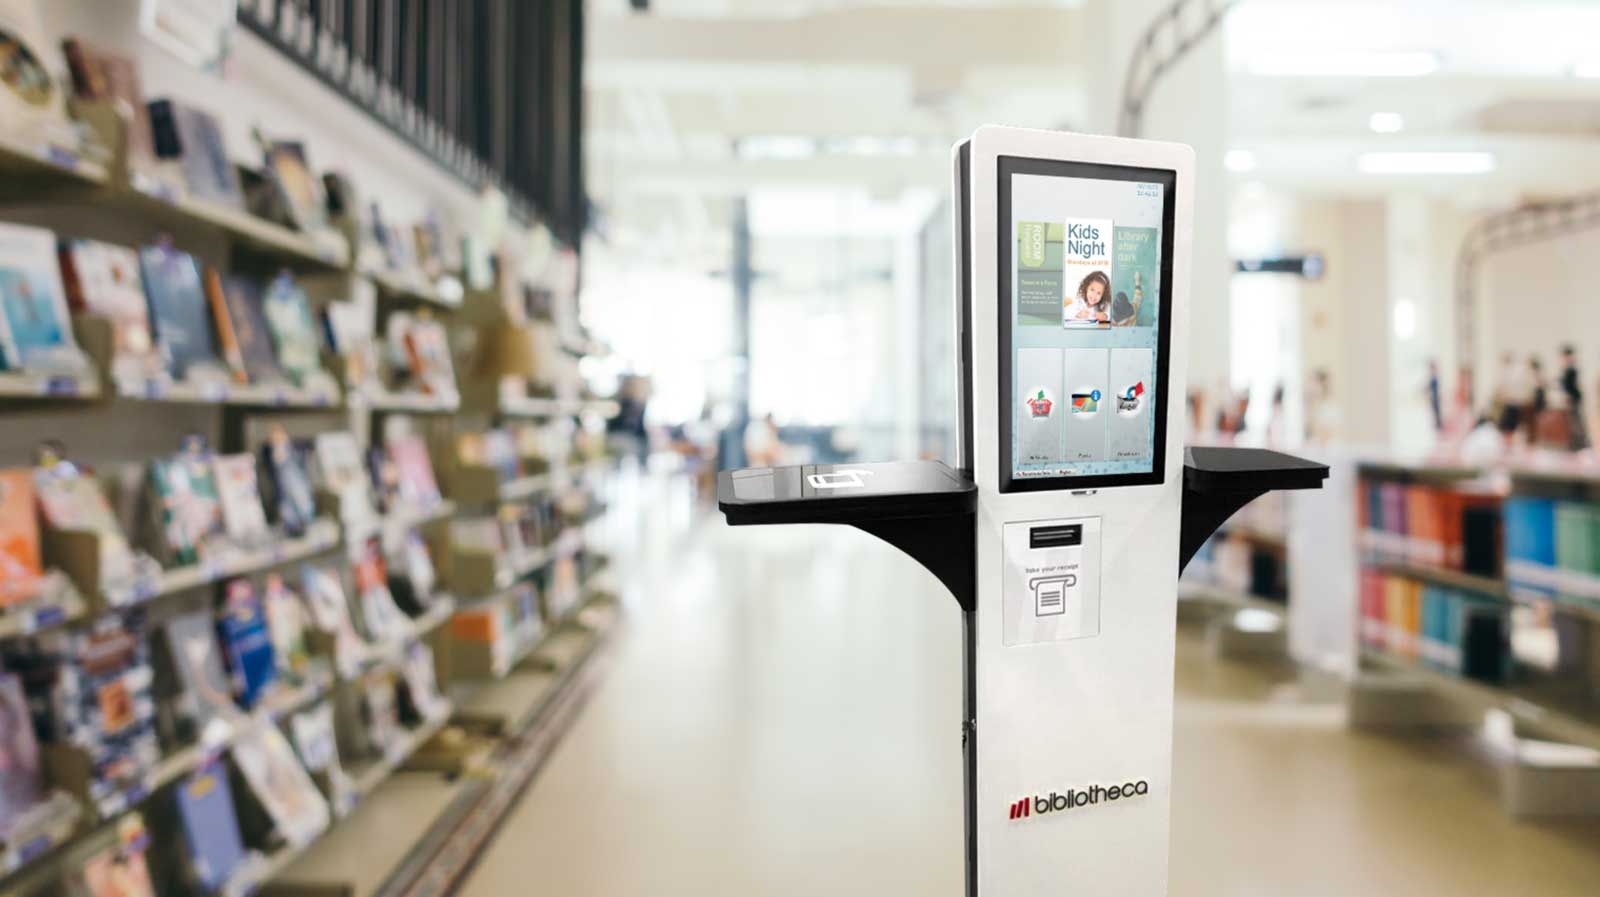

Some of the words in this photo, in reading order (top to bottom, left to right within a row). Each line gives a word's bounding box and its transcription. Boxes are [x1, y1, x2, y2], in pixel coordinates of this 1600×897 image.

[1032, 223, 1042, 260] ROOM
[1067, 223, 1100, 240] Kids
[1067, 240, 1105, 259] Night
[1034, 780, 1149, 814] bibliotheca
